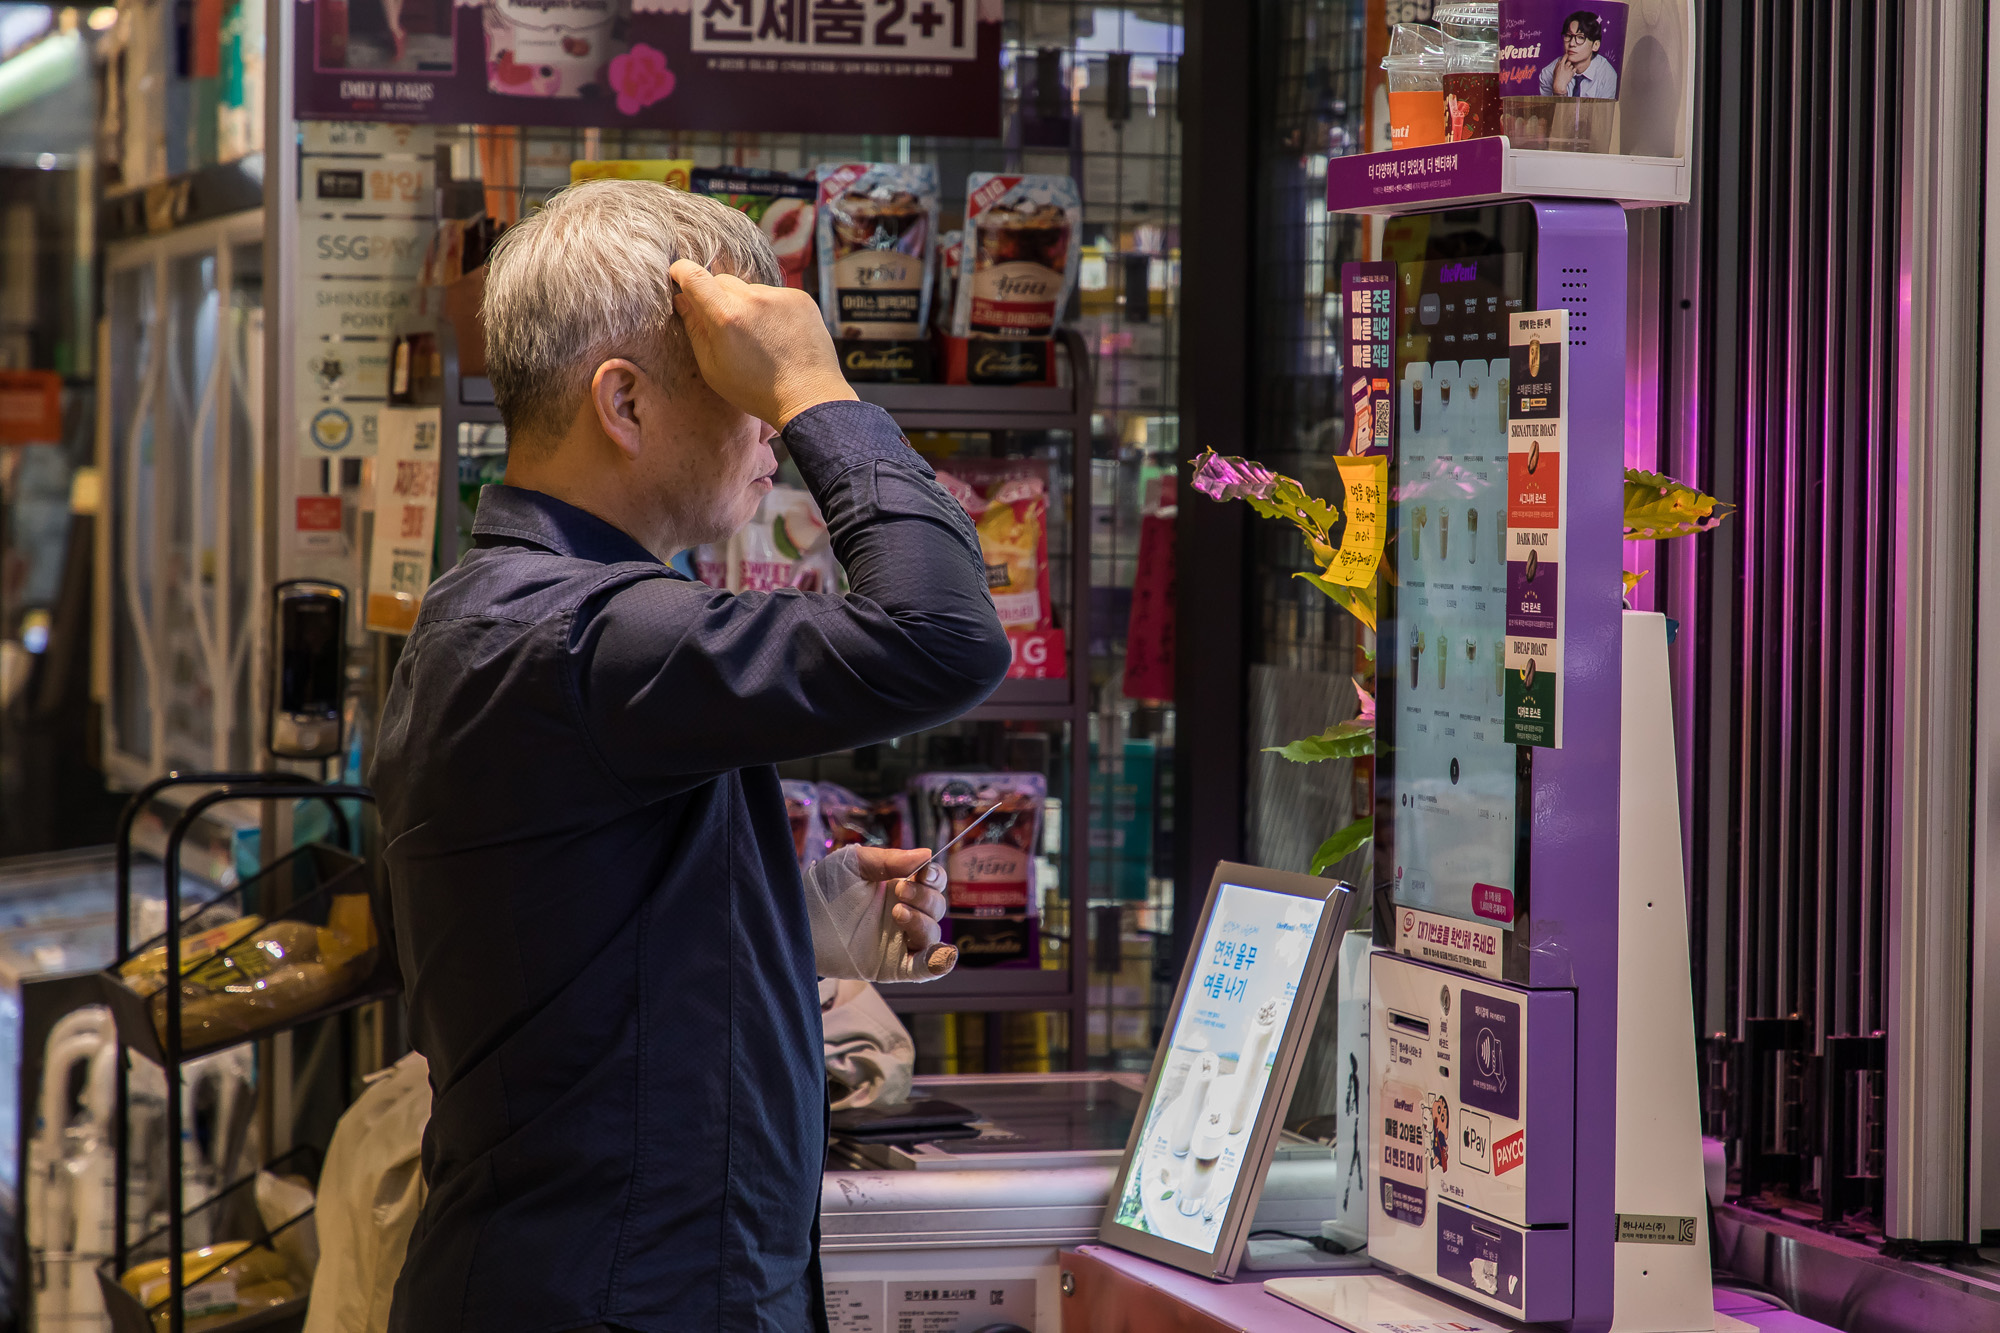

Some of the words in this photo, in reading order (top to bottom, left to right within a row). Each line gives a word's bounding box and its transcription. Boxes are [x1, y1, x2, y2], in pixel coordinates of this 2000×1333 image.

[379, 81, 393, 99] IN
[395, 82, 434, 102] PARIS
[1368, 163, 1375, 180] 더
[1375, 161, 1399, 179] 다양하게,
[1401, 160, 1407, 177] 더
[1407, 158, 1427, 176] 맛있게,
[1427, 156, 1433, 174] 더
[1434, 153, 1458, 173] 벤티하게
[1440, 260, 1477, 283] theVenti
[1373, 289, 1390, 313] 주문
[1373, 317, 1390, 341] 픽업
[1373, 344, 1390, 368] 적립
[1511, 424, 1539, 438] SIGNATURE
[1540, 423, 1557, 437] ROAST
[1519, 493, 1534, 504] 시그니처
[1535, 493, 1547, 504] 로스트
[1516, 532, 1531, 546] DARK
[1531, 532, 1549, 546] ROAST
[1521, 602, 1529, 614] 다크
[1530, 602, 1542, 613] 로스트
[1010, 636, 1048, 665] IG
[1513, 641, 1530, 655] DECAF
[1530, 643, 1548, 656] ROAST
[1529, 707, 1541, 719] 로스트
[1417, 921, 1450, 947] 대기번호를
[1450, 927, 1472, 951] 확인해
[1472, 932, 1496, 956] 주세요!
[1213, 940, 1236, 967] 연천
[1234, 943, 1257, 971] 율무
[1203, 972, 1225, 999] 여름
[1225, 976, 1248, 1003] 나기
[1385, 1118, 1397, 1139] 매월
[1399, 1122, 1423, 1145] 20일은
[1471, 1128, 1486, 1159] Pay
[1496, 1137, 1524, 1168] PAYCO
[1623, 1221, 1666, 1233] 하나시스(주)
